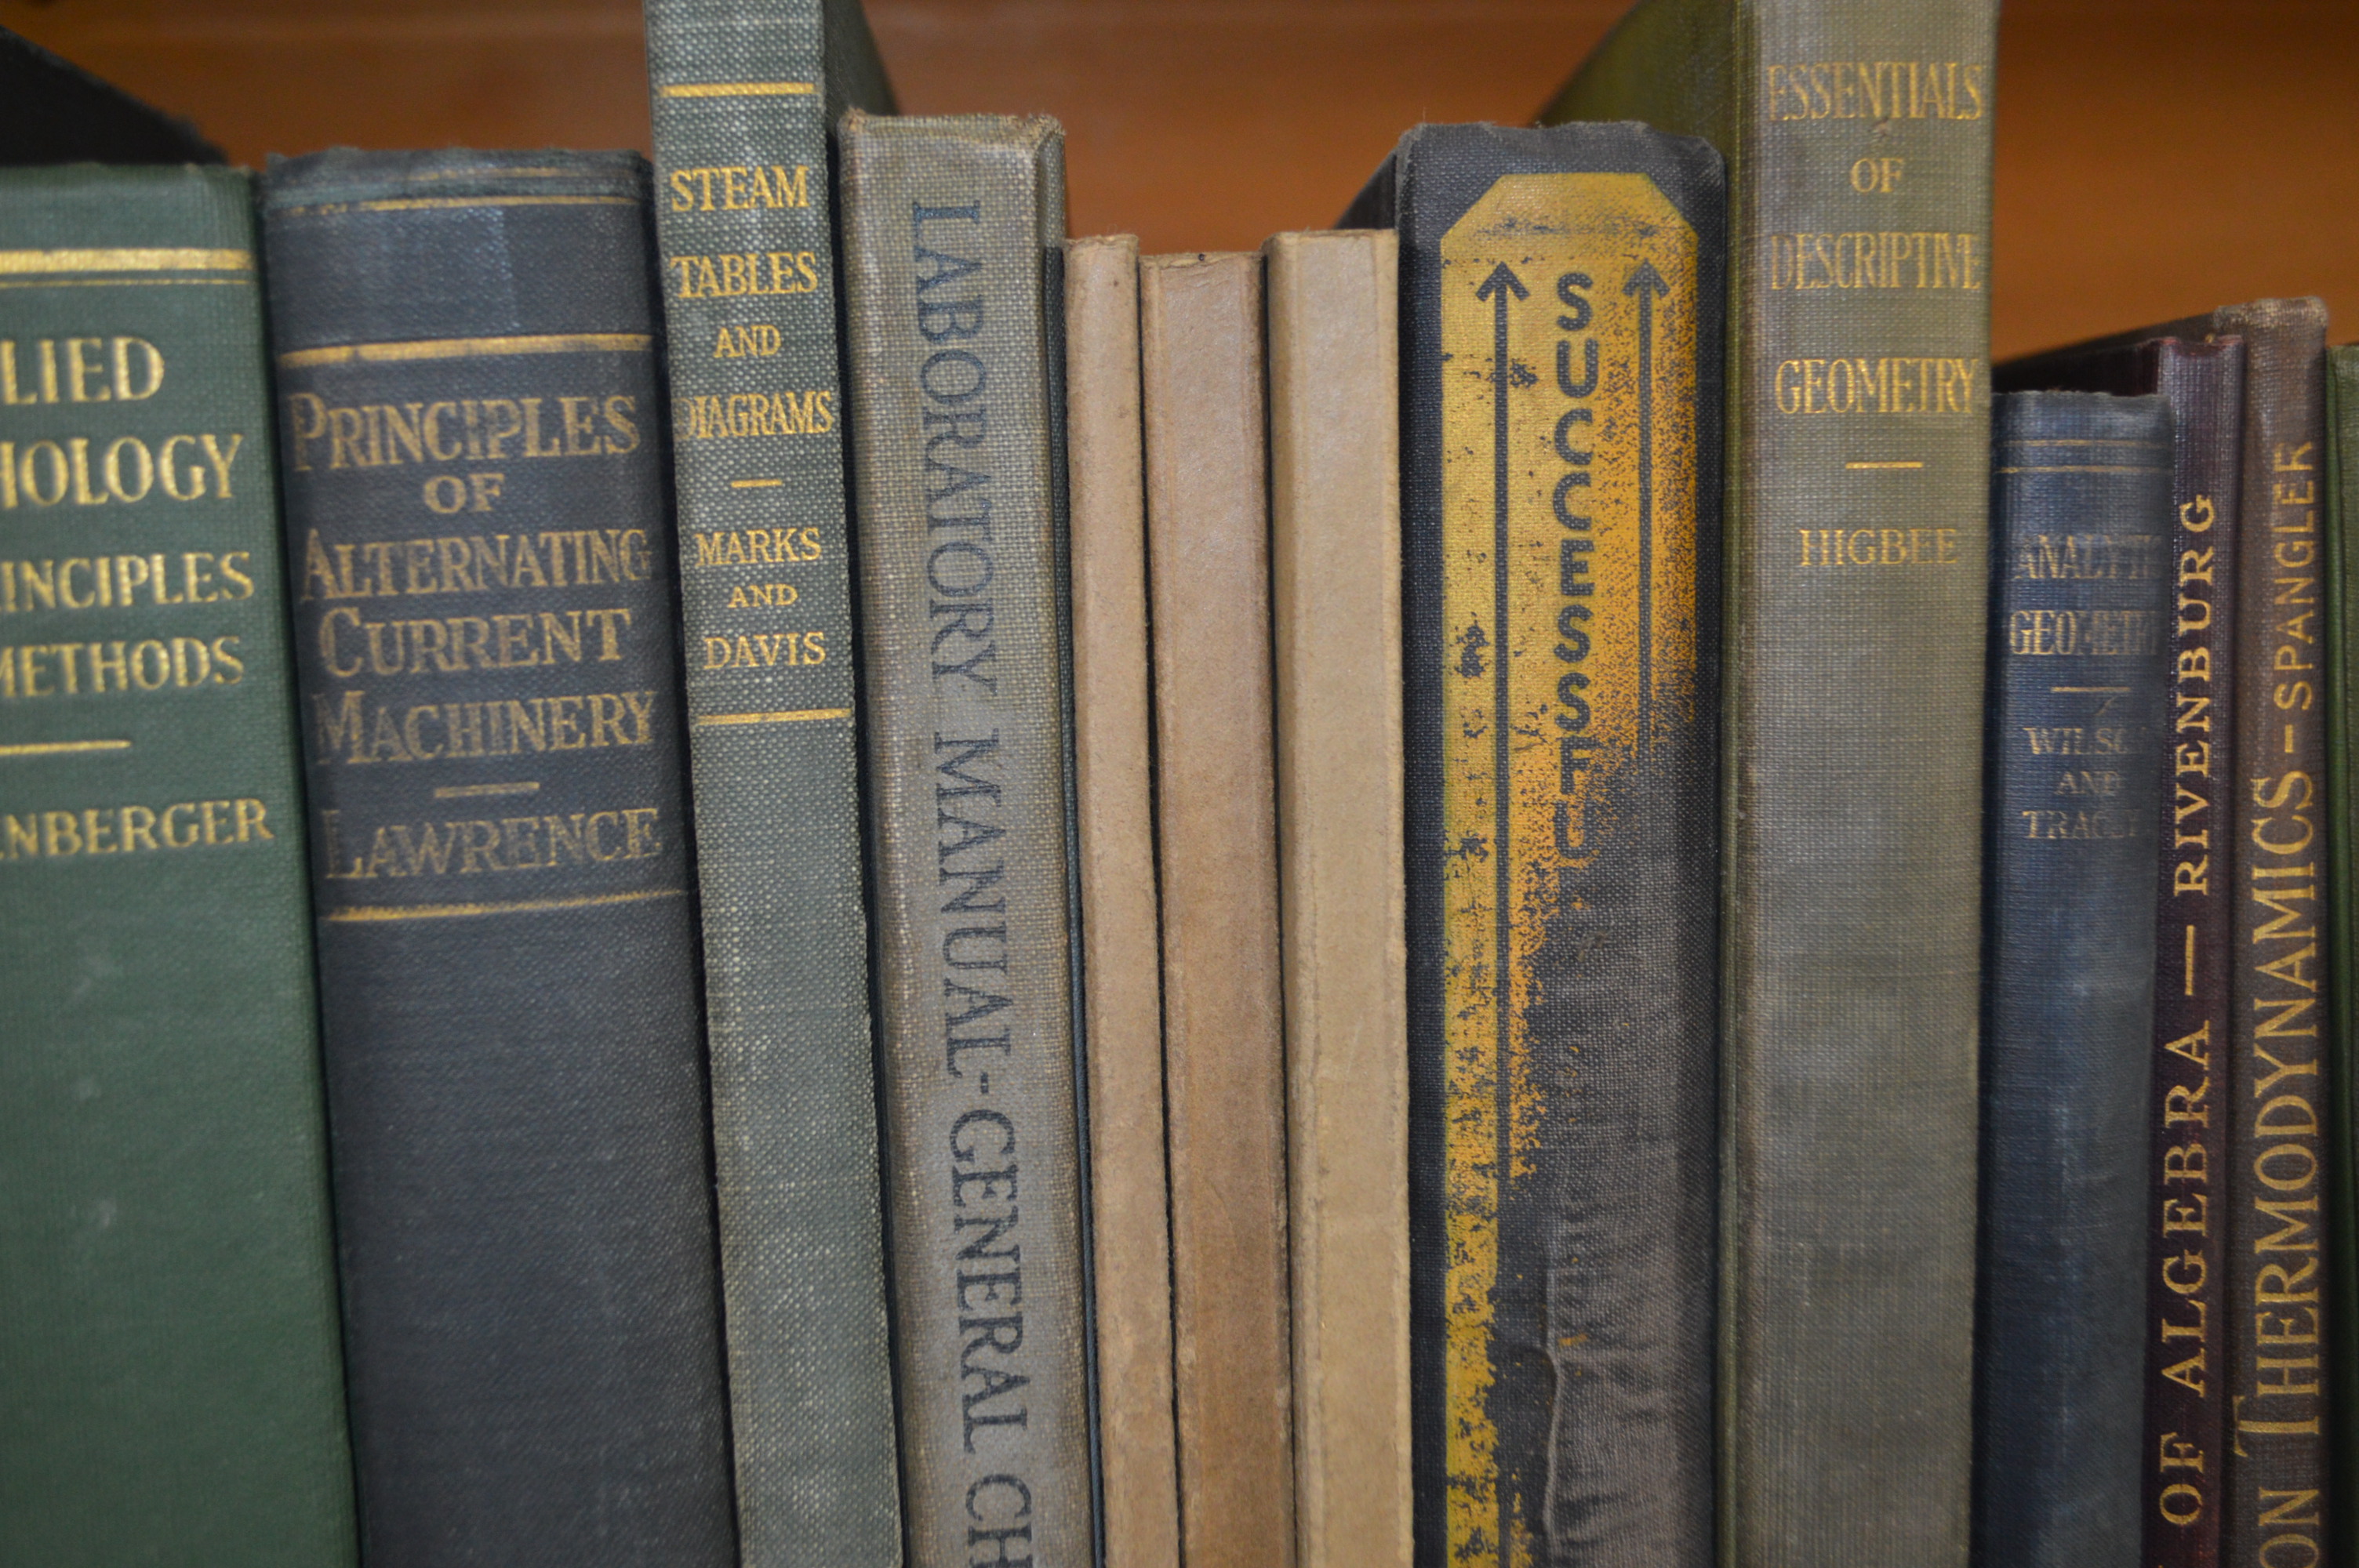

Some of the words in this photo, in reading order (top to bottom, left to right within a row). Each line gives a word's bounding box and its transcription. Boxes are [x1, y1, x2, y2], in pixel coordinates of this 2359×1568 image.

[1766, 61, 1983, 120] ESSENTIALS
[670, 165, 811, 212] STEAM
[1851, 157, 1904, 193] OF
[670, 251, 819, 299] TABLES
[1770, 231, 1982, 290] DESCRIPTIVE
[713, 324, 783, 359] AND
[671, 390, 834, 439] DIAGRAMS
[1774, 357, 1979, 415] GEOMETRY
[288, 391, 642, 472] PRINCIPLES
[912, 199, 999, 695] LABORATORY
[422, 473, 506, 514] OF
[300, 528, 652, 601] ALTERNATING
[694, 527, 823, 568] MARKS
[1798, 528, 1958, 566] HIGBEE
[2274, 439, 2315, 711] SPANGLER
[727, 583, 799, 609] AND
[1551, 271, 1600, 886] SUCCESSFU
[318, 606, 632, 678] CURRENT
[703, 631, 827, 670] DAVIS
[2173, 493, 2215, 898] RIVENBURG
[312, 689, 659, 765] MACHINERY
[2052, 770, 2122, 795] AND
[0, 797, 275, 861] NBERGER
[322, 807, 663, 880] LAWRENCE
[2233, 769, 2321, 1457] THERMODYNAMICS
[2160, 1019, 2212, 1399] ALGEBRA
[2159, 1432, 2205, 1526] OF
